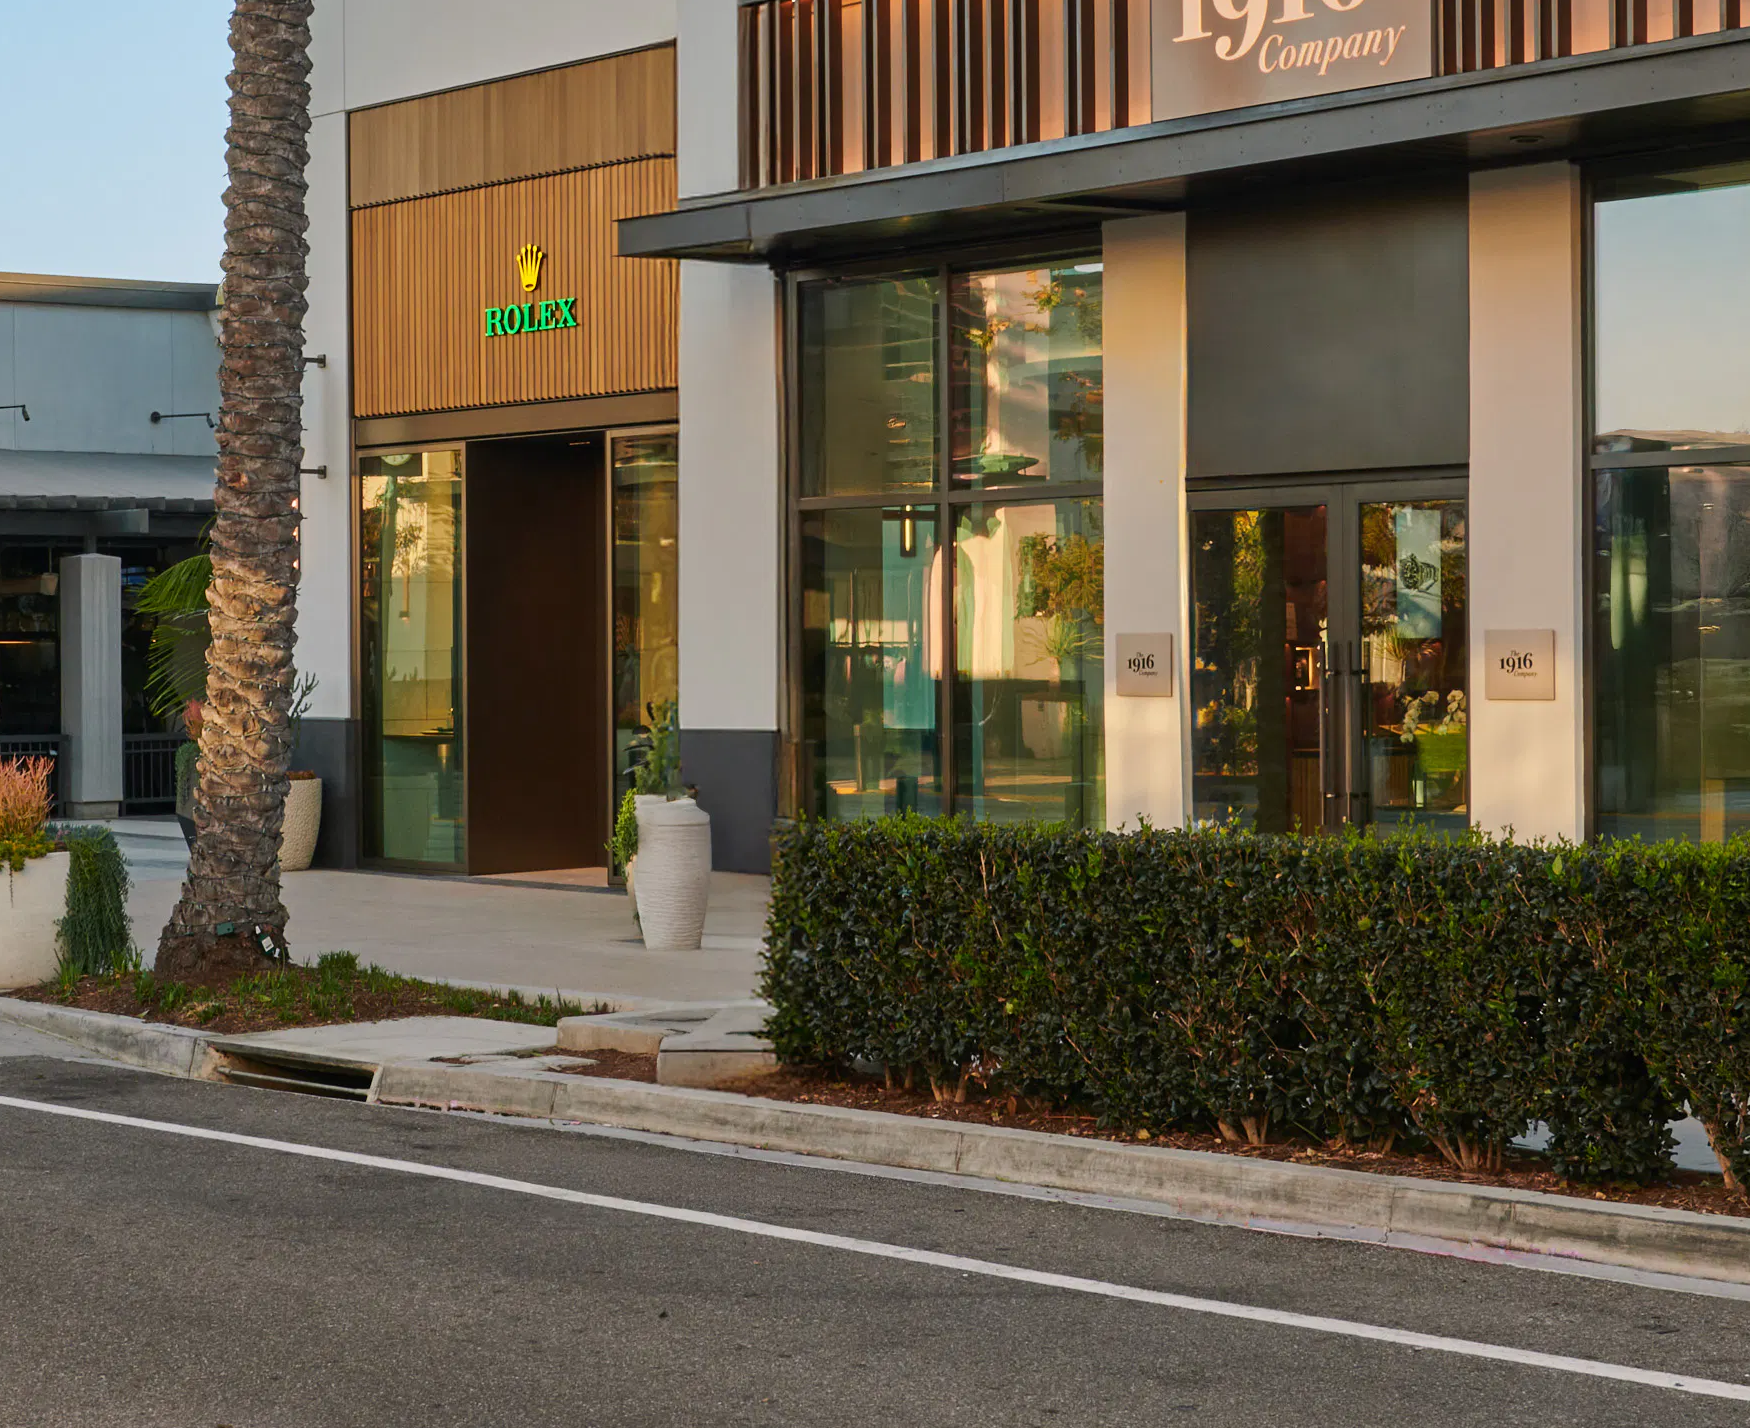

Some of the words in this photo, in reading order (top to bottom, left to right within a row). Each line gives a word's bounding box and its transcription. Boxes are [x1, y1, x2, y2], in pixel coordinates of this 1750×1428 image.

[1259, 25, 1406, 76] Company
[485, 298, 577, 337] ROLEX
[1127, 653, 1155, 673] 1916
[1499, 652, 1533, 673] 1916
